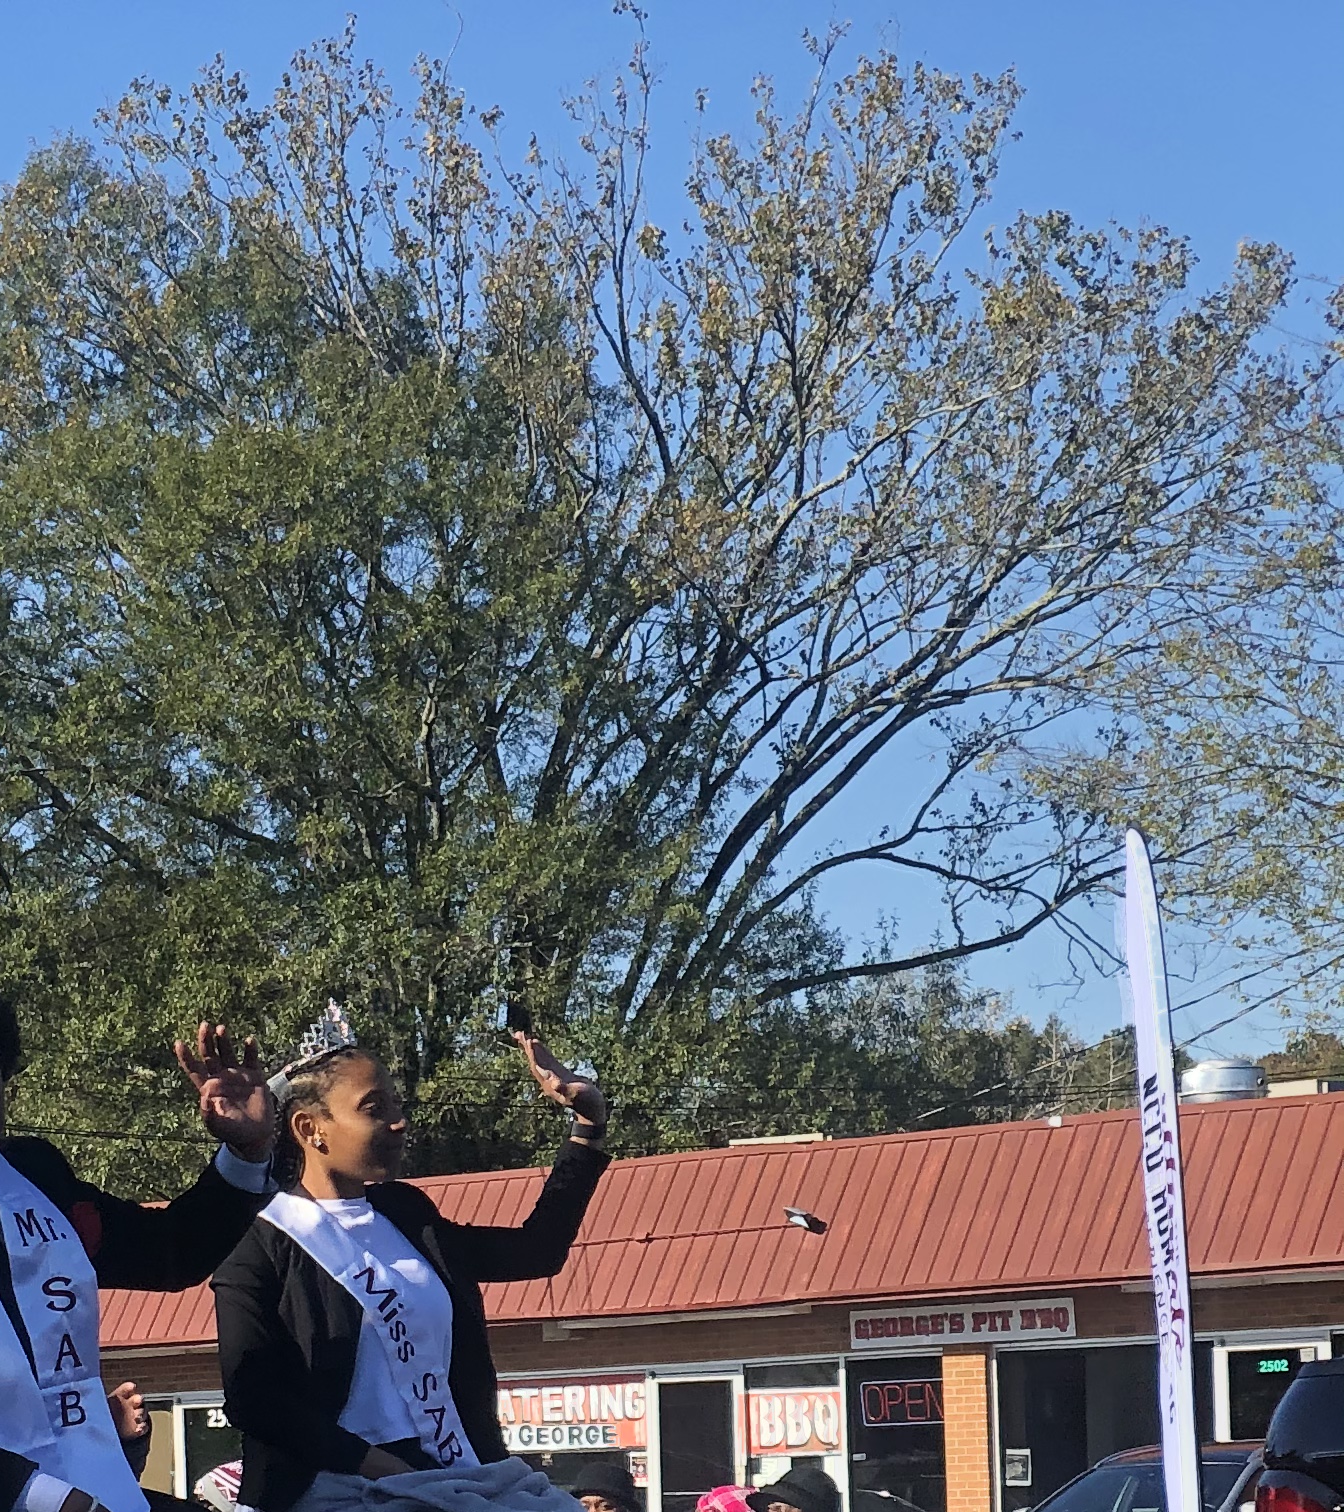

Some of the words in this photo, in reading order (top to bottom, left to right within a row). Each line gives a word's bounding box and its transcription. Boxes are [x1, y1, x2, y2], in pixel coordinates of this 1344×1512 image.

[13, 1208, 67, 1248] Mr.
[855, 1312, 966, 1341] GEORGE'S
[972, 1309, 1014, 1333] PIT
[353, 1265, 416, 1364] Miss
[412, 1372, 464, 1468] SAB
[1259, 1359, 1290, 1374] 2502
[497, 1381, 647, 1424] ATERING
[758, 1393, 840, 1448] BBQ
[864, 1384, 945, 1423] OPEN
[518, 1424, 618, 1447] GEORGE
